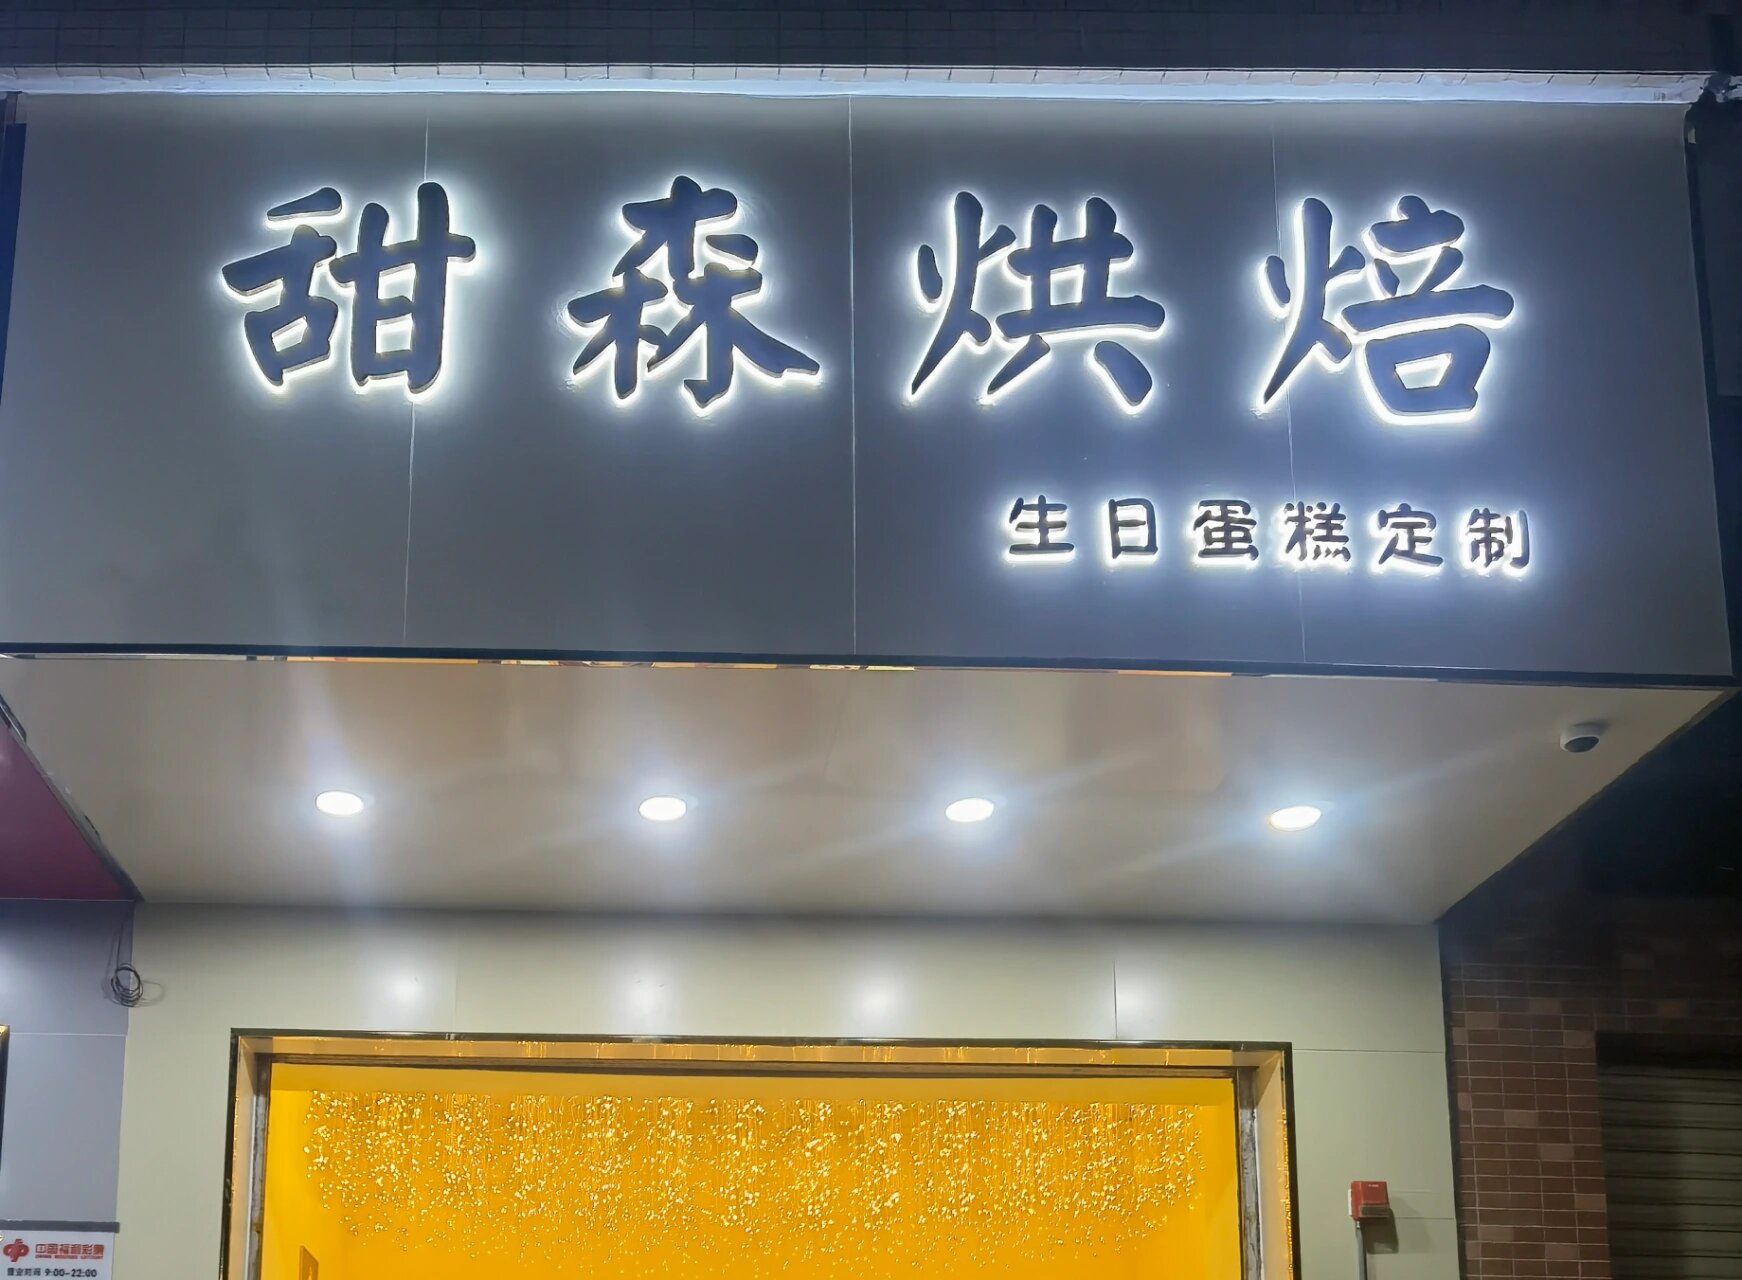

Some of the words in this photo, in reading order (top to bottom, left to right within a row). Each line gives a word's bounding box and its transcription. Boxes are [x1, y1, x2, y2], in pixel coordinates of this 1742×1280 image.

[221, 175, 1515, 418] 甜森烘焙
[1008, 495, 1531, 572] 生日蛋糕定制
[44, 1268, 97, 1278] 9:00-22:00
